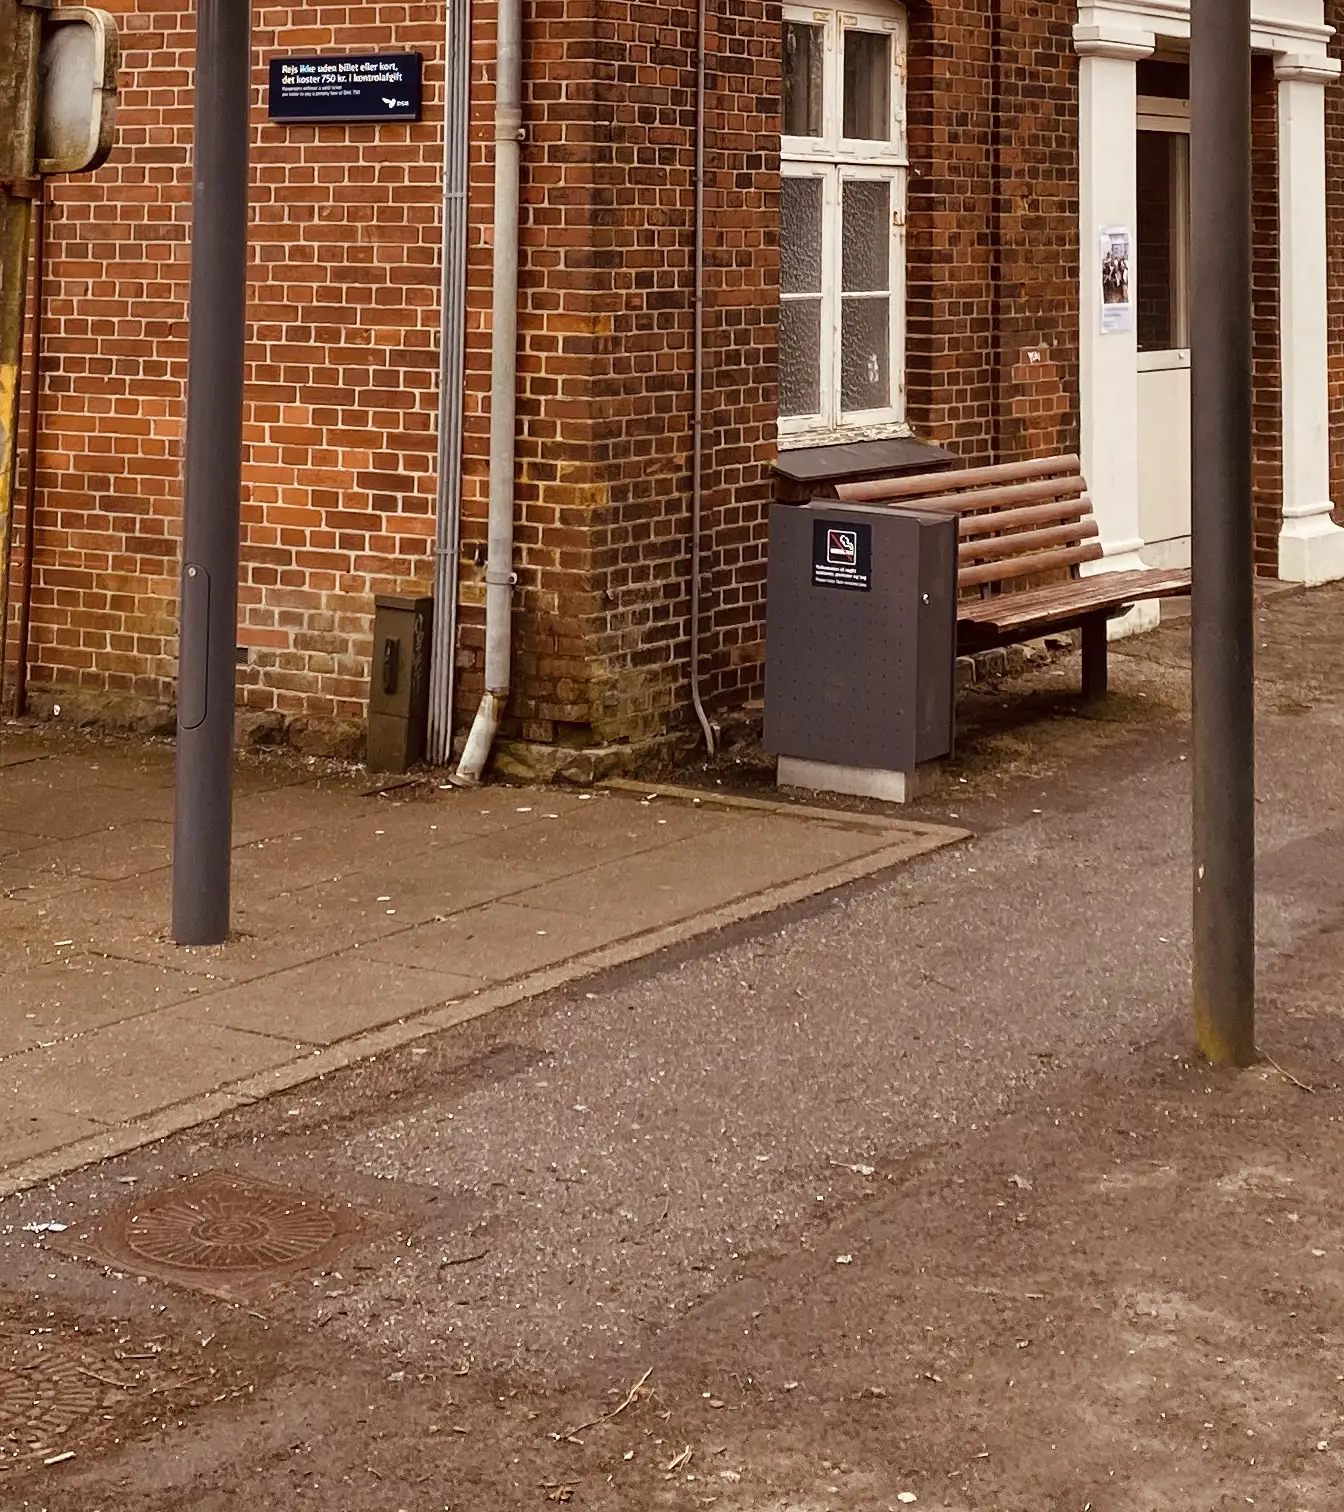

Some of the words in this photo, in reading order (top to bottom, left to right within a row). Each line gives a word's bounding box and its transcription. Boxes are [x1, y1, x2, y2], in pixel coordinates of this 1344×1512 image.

[282, 65, 298, 75] Rejs
[300, 64, 316, 73] ikke
[318, 63, 337, 73] uden
[338, 63, 358, 72] billet
[360, 62, 378, 71] eller
[282, 75, 295, 84] det
[296, 74, 320, 84] koster
[321, 74, 336, 83] 750
[337, 73, 347, 83] kr.
[353, 72, 403, 83] kontrolafgift
